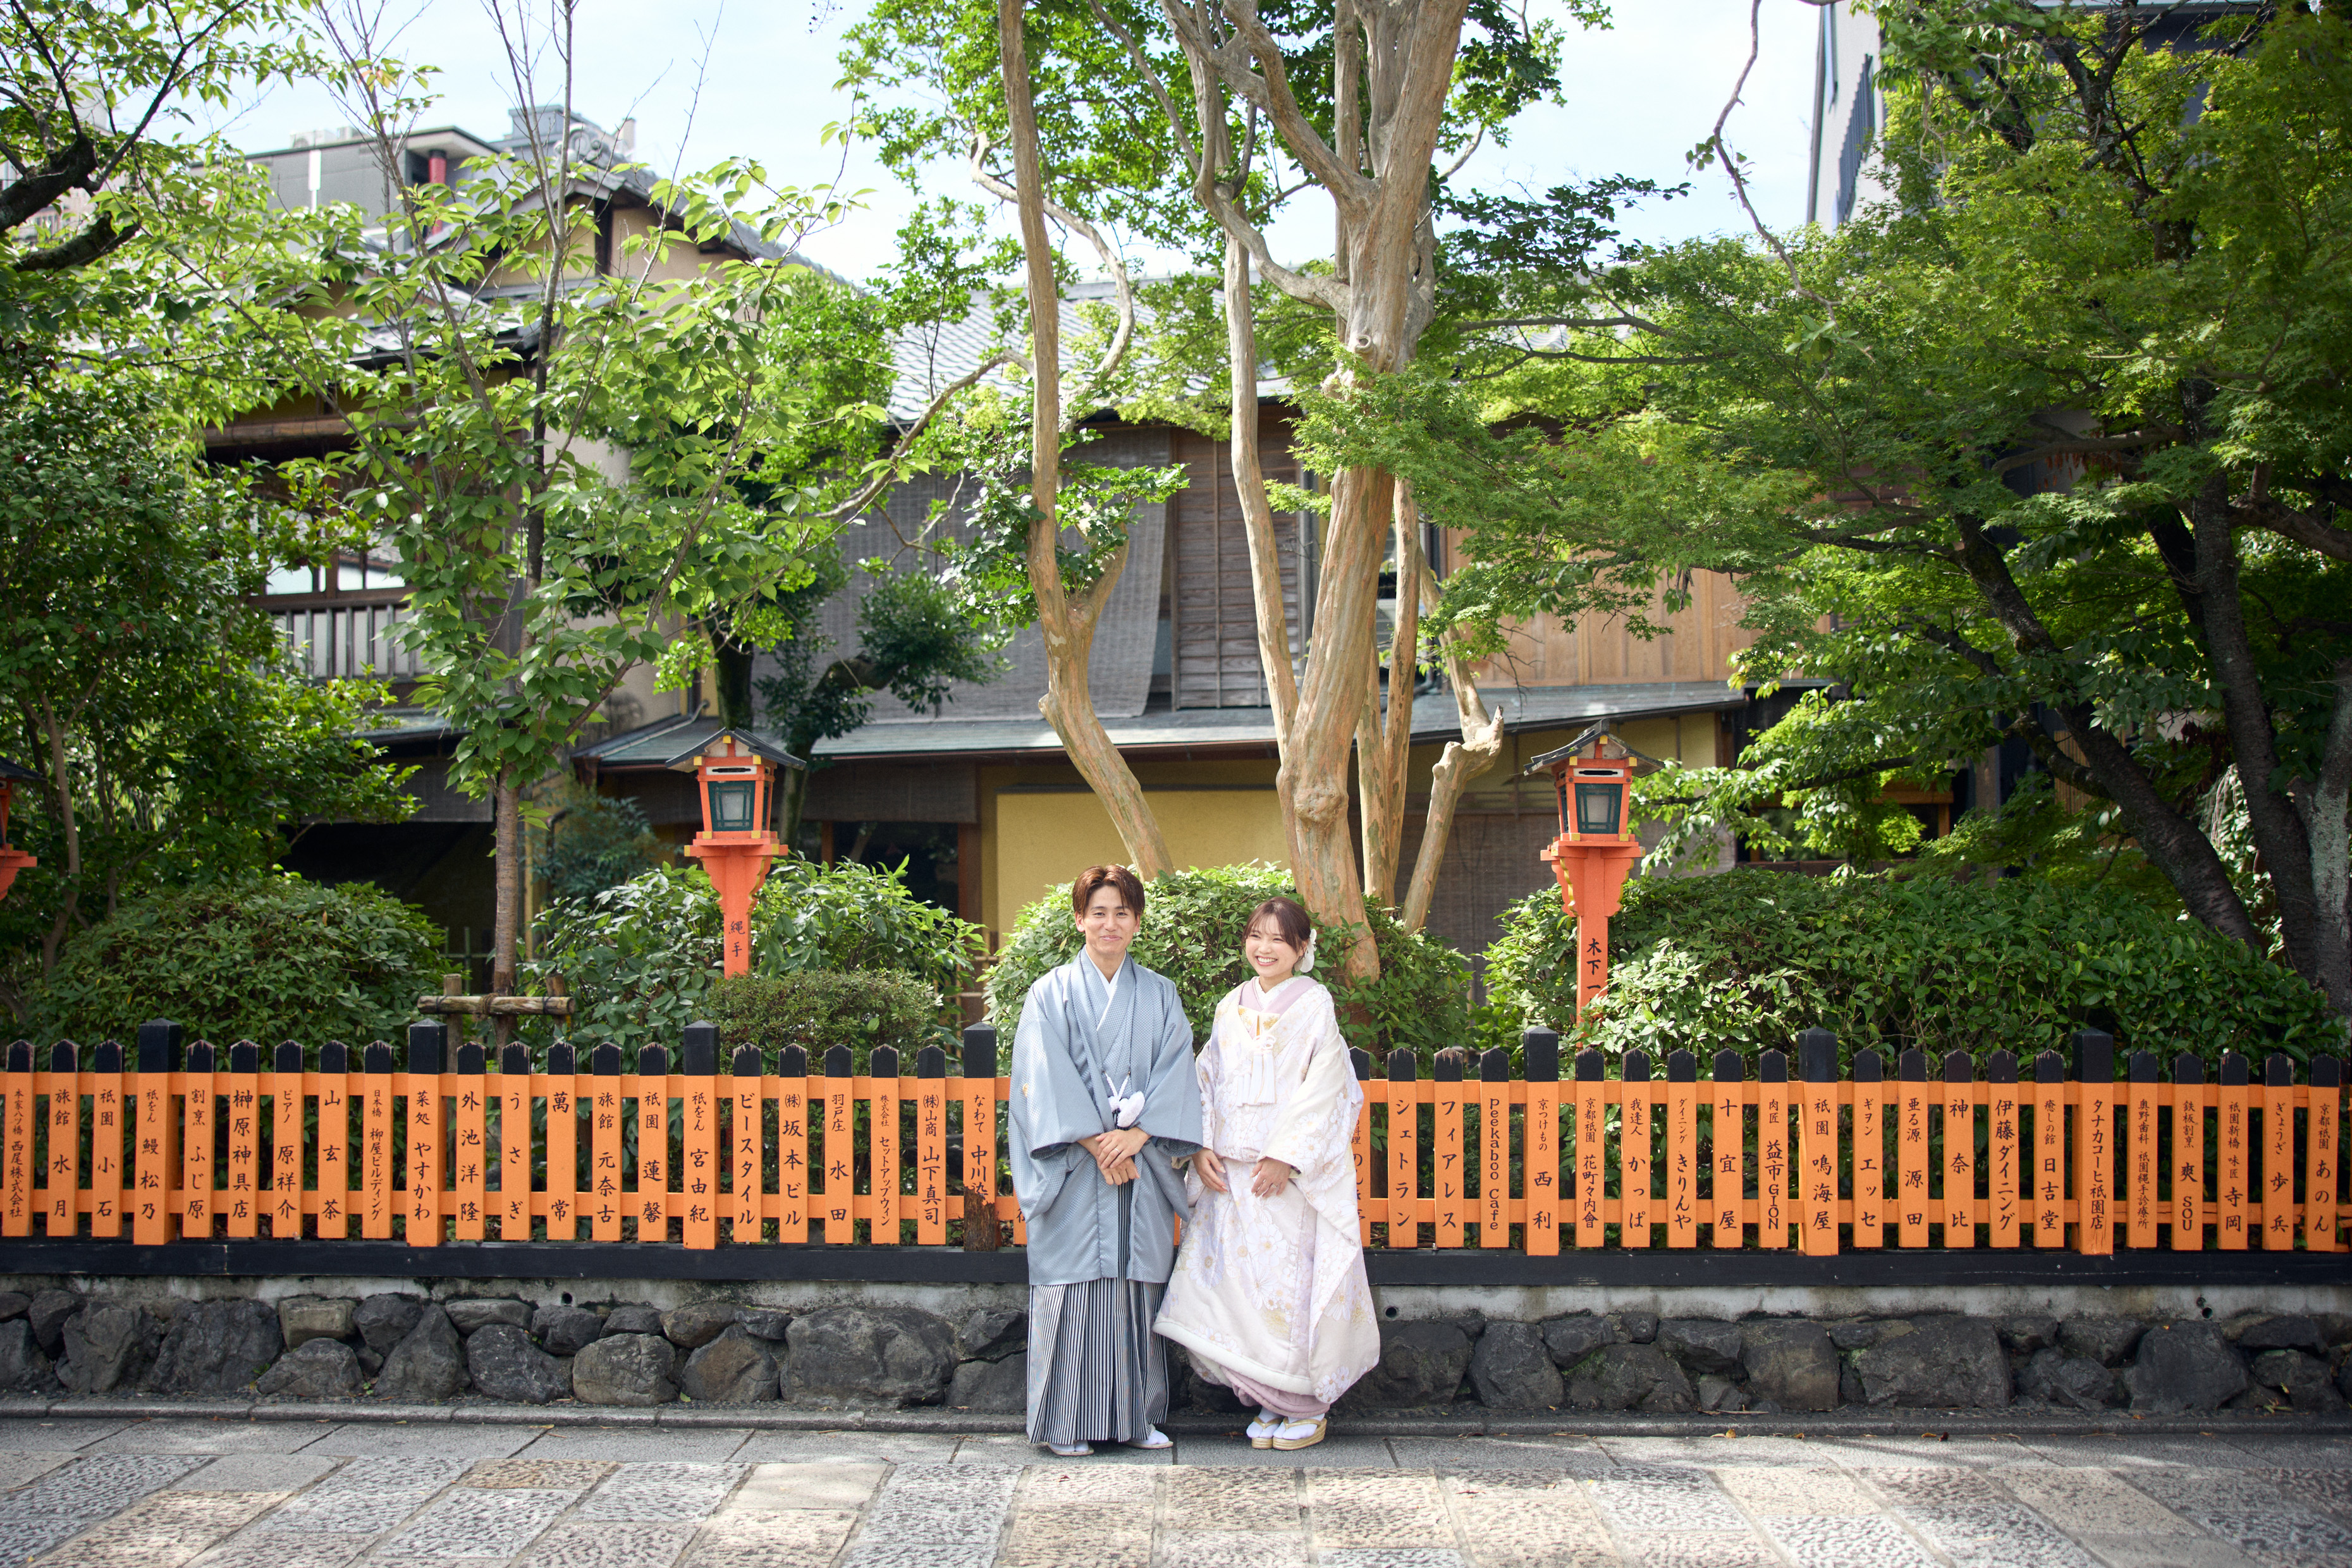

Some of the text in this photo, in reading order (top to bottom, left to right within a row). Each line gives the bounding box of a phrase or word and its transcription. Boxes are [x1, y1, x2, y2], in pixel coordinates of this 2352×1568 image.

[728, 921, 745, 957] 縄手
[52, 1089, 71, 1218] 旅館 水月
[142, 1138, 159, 1155] 鰻
[187, 1089, 205, 1220] 割烹 ふじ原
[232, 1089, 254, 1218] 榊原神具店
[277, 1091, 297, 1220] ピアノ 原祥介
[322, 1090, 341, 1220] 山玄茶
[370, 1089, 384, 1220] 日本橋 柳屋ビルディング
[413, 1090, 431, 1221] 菜処 やすかわ
[460, 1091, 481, 1222] 外池洋隆
[509, 1093, 523, 1220] うさぎ
[551, 1091, 570, 1222] 萬常
[597, 1092, 616, 1223] 旅館 元奈古
[739, 1093, 755, 1225] ビースタイル
[782, 1120, 804, 1225] 坂本ビル
[880, 1094, 890, 1127] 株式会社
[974, 1094, 985, 1133] なわて
[1396, 1099, 1412, 1227] シェトラン
[1441, 1101, 1457, 1228] フィアレス
[1533, 1098, 1552, 1230] 京つけもの 西利
[1628, 1098, 1646, 1229] 我逢人 かっぱ
[1674, 1098, 1691, 1230] ダイニング きりんや
[1769, 1098, 1779, 1124] 肉匠
[1860, 1098, 1877, 1227] ギヲン エッセ
[1949, 1099, 1970, 1228] 神奈比
[1995, 1099, 2016, 1230] 伊藤ダイニング
[2181, 1162, 2198, 1182] 爽
[2270, 1102, 2289, 1233] ぎょうざ 歩兵
[9, 1141, 23, 1218] 西尾株式会社
[97, 1156, 114, 1217] 小石
[689, 1148, 709, 1223] 宮由紀
[830, 1160, 849, 1221] 水田
[922, 1146, 941, 1225] 山下真司
[1812, 1154, 1833, 1230] 鳴海屋
[1905, 1170, 1923, 1225] 源田
[2041, 1158, 2059, 1230] 日吉堂
[2182, 1196, 2193, 1231] SOU
[2224, 1187, 2243, 1232] 寺岡
[2314, 1160, 2331, 1232] あのん
